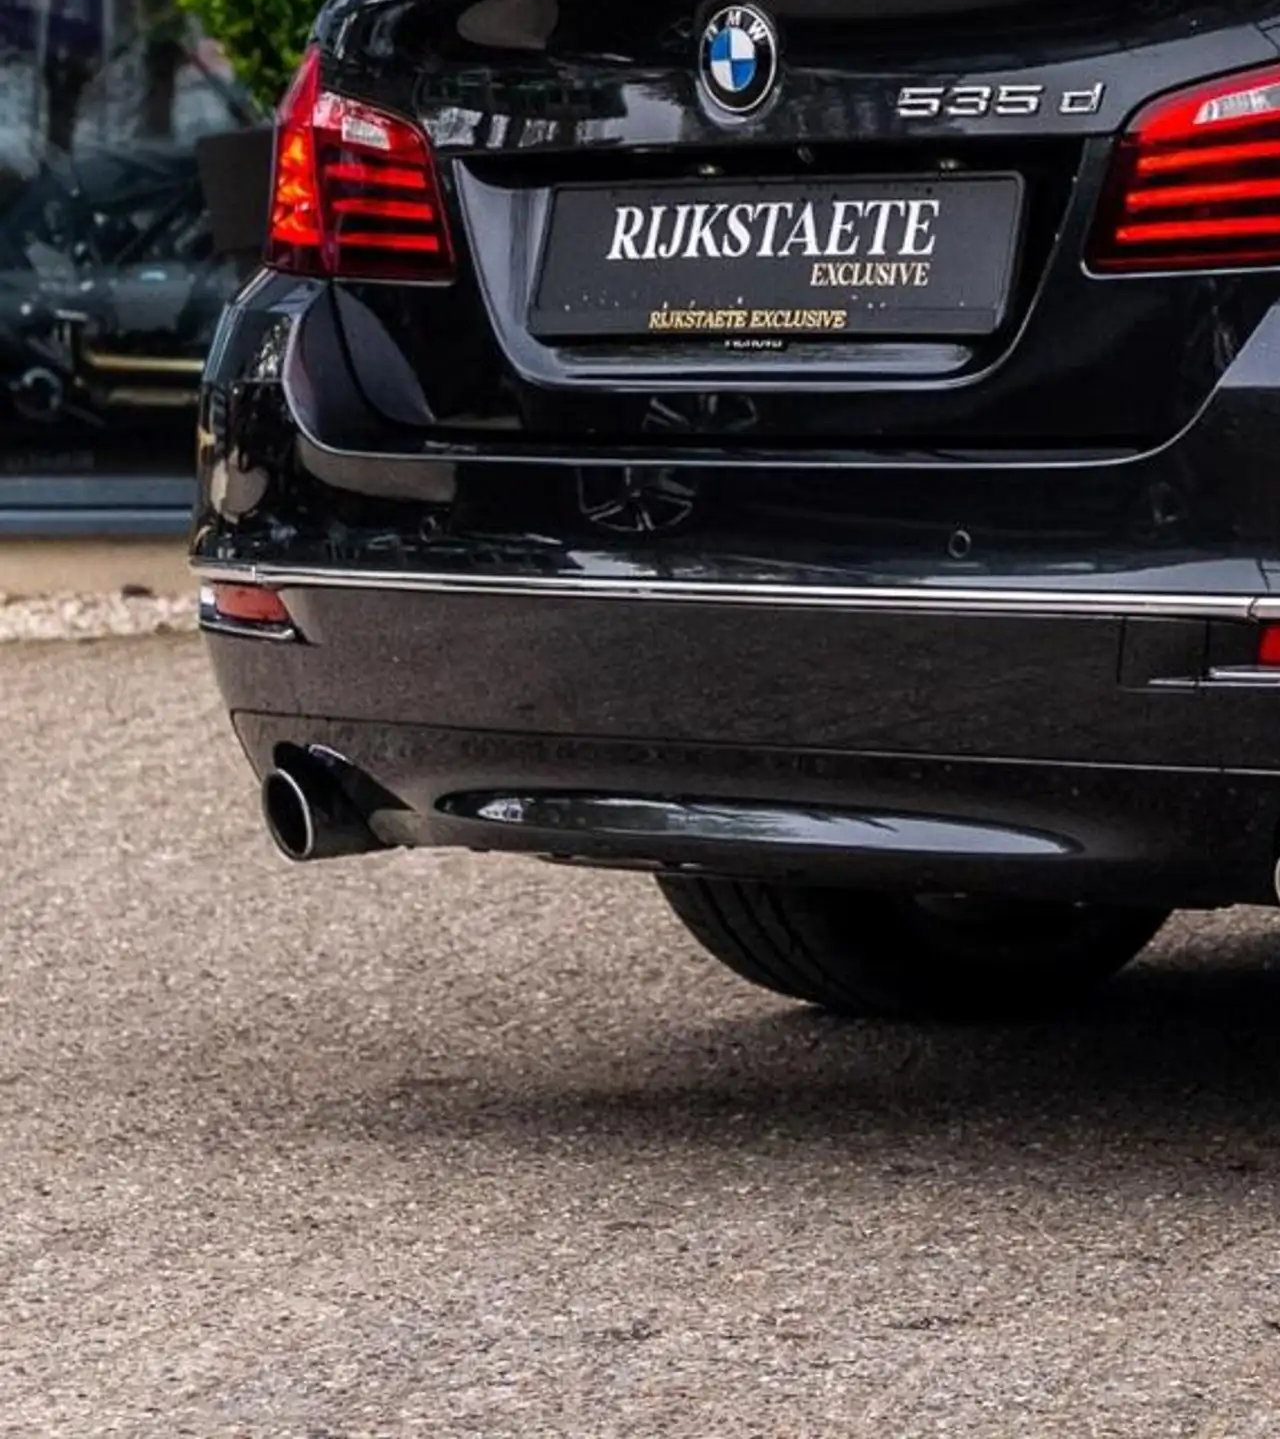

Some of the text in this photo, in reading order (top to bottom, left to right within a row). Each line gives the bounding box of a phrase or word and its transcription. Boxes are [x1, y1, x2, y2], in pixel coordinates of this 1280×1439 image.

[898, 82, 1104, 116] 535 d
[605, 199, 940, 260] RIJKSTAETE
[809, 262, 930, 287] EXCLUSIVE
[648, 309, 847, 329] RIJKSTAETE EXCLUSIVE
